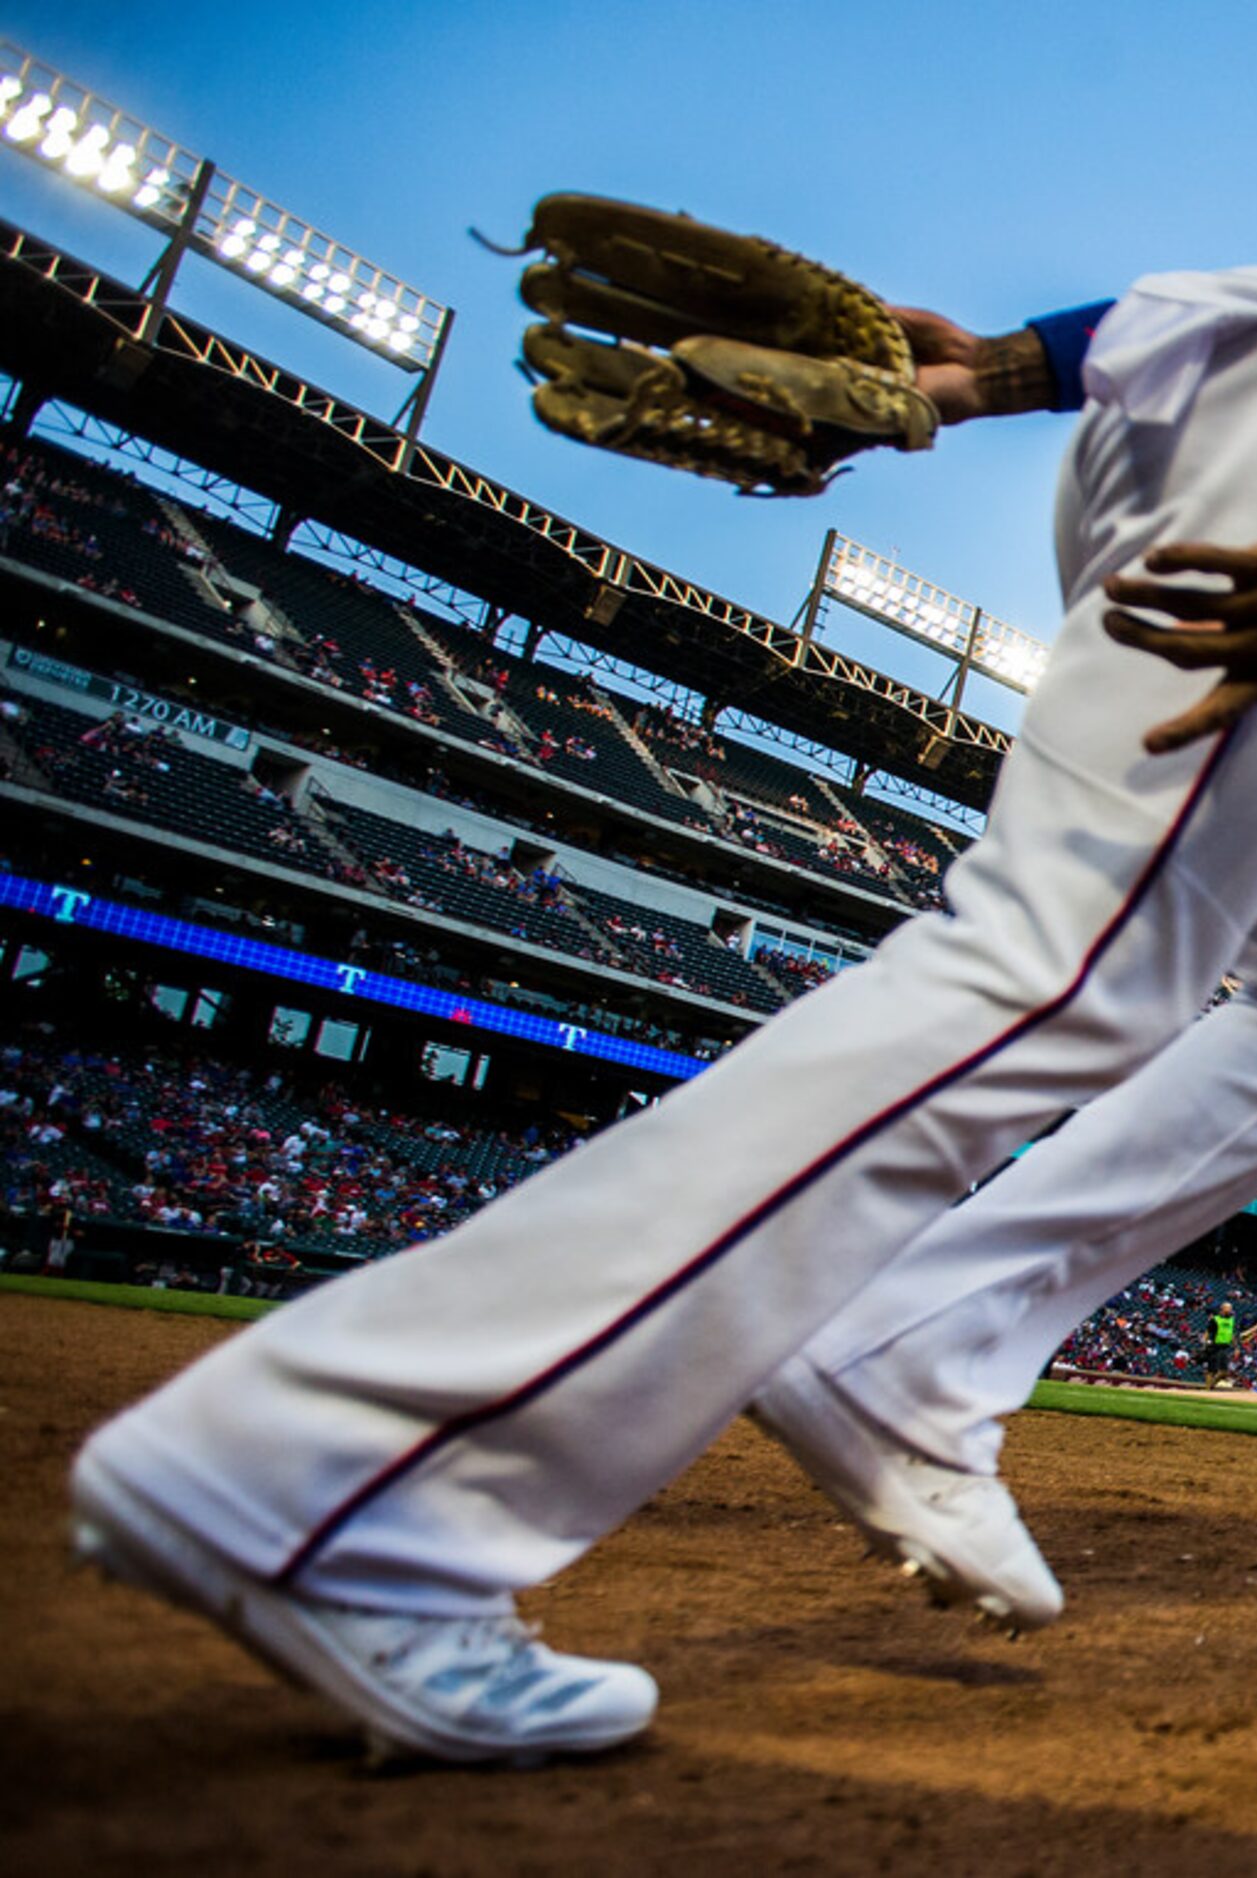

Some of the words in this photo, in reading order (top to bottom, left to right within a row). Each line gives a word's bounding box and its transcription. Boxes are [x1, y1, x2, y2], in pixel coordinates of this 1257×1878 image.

[110, 685, 170, 720] 1270
[172, 708, 217, 738] AM
[52, 885, 91, 922] T
[337, 964, 366, 994] T
[559, 1023, 587, 1051] T
